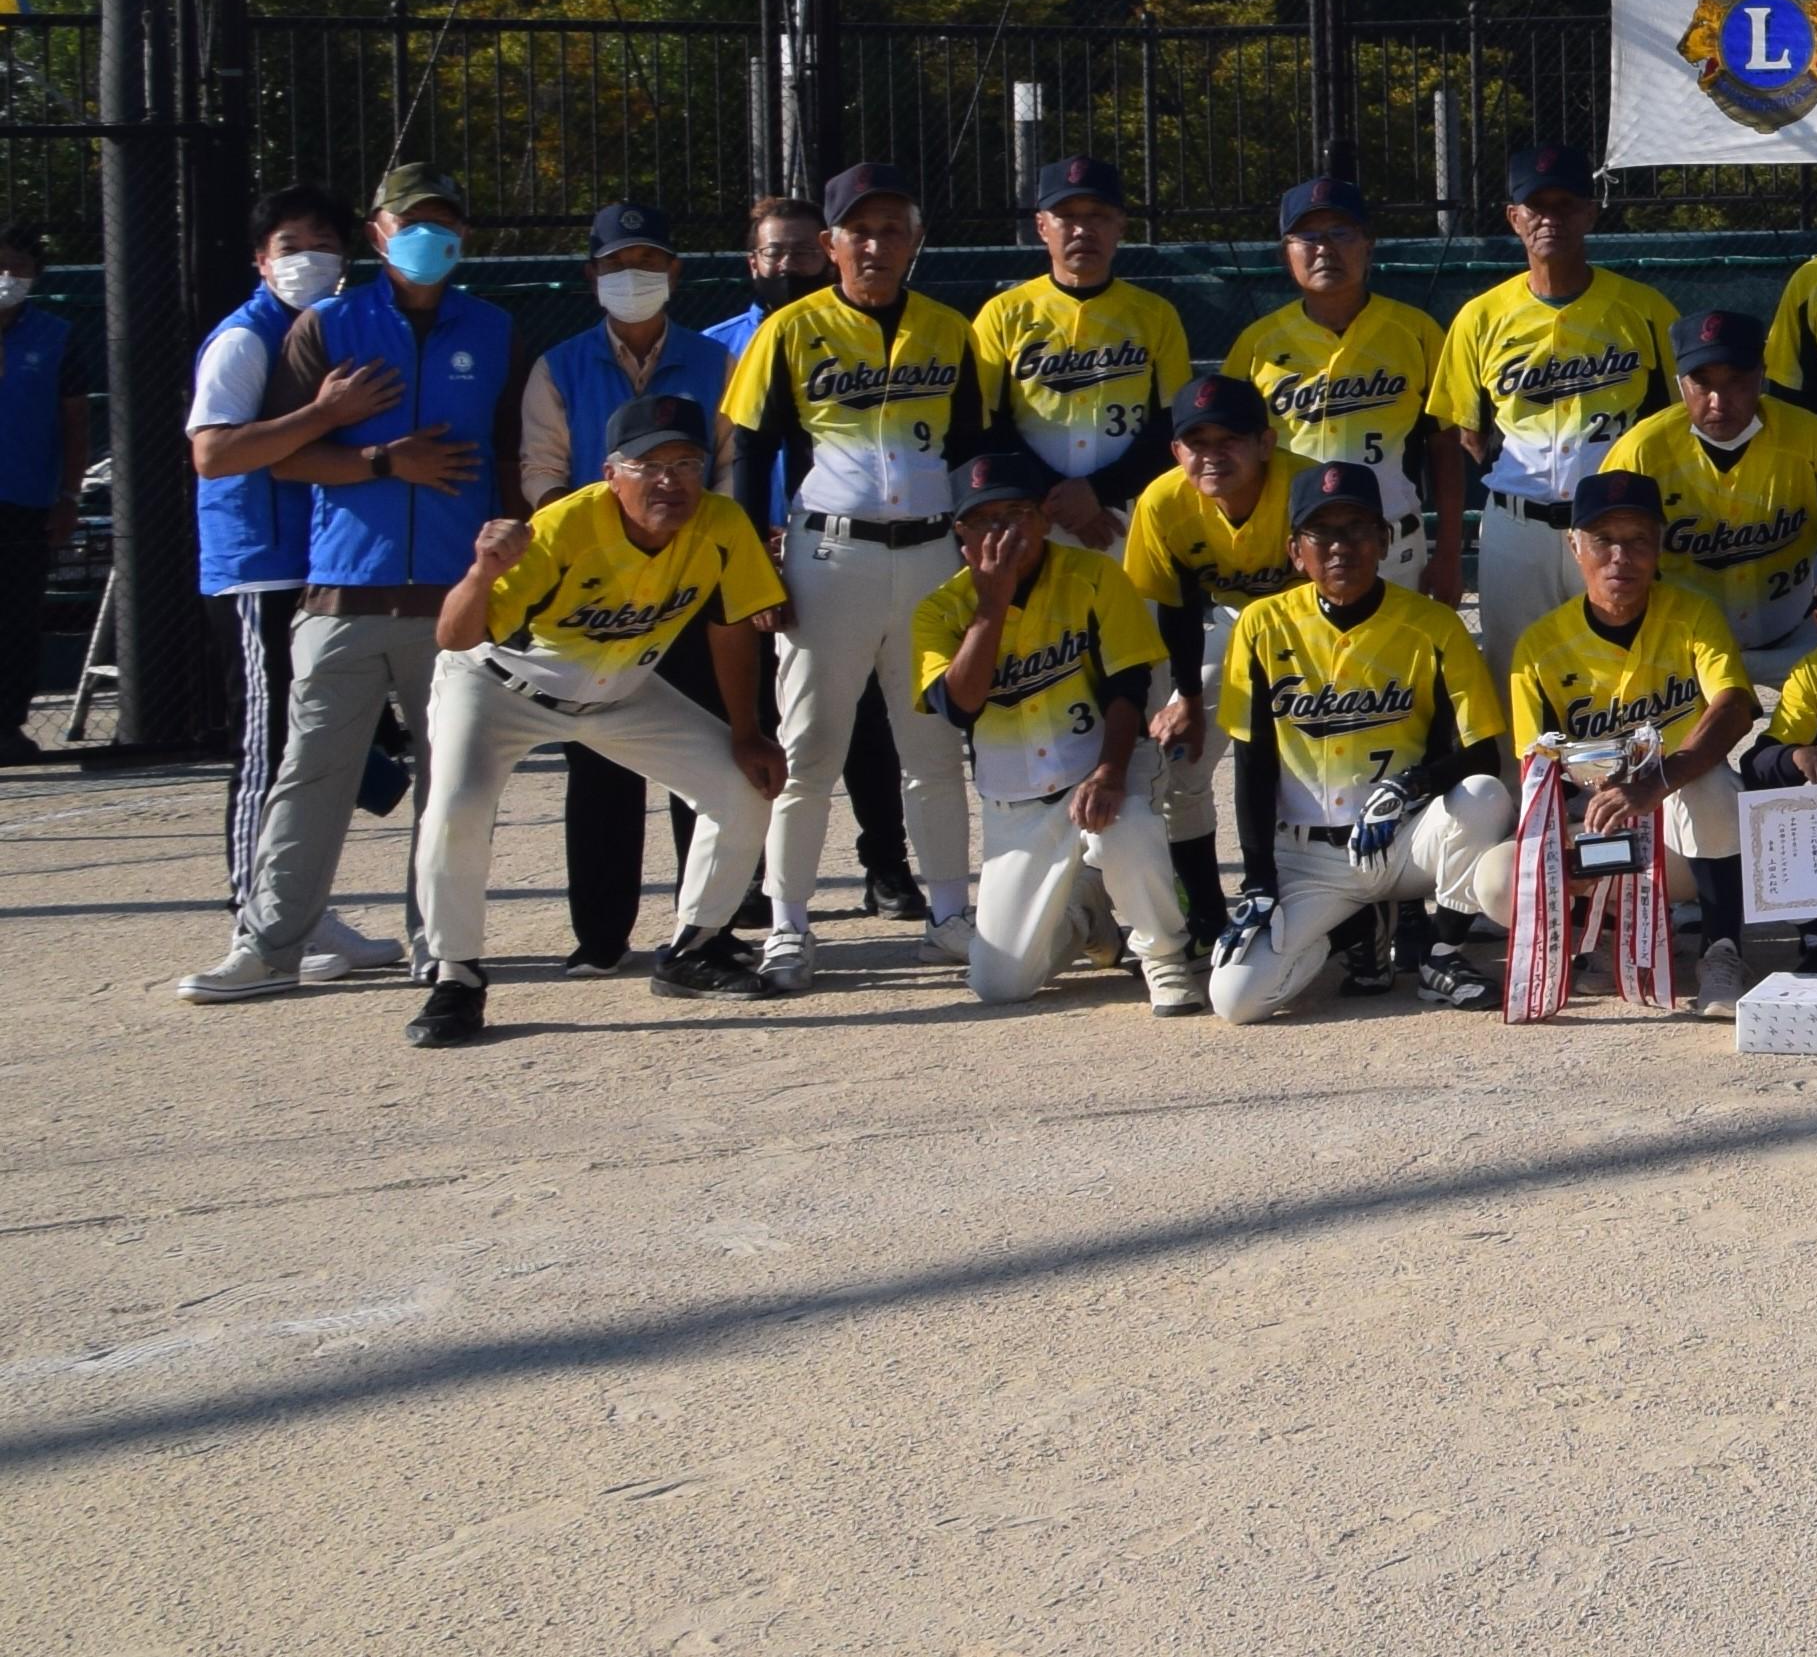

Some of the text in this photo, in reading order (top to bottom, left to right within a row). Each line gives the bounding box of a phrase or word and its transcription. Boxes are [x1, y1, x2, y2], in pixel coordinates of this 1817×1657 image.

[1743, 7, 1793, 70] L
[1014, 338, 1149, 382] Gokasho
[1498, 345, 1641, 394] Gokasho
[1271, 367, 1407, 417] Gokasho
[914, 421, 932, 452] 9
[1364, 432, 1384, 465] 5
[1663, 506, 1808, 557] Gokasho
[1067, 701, 1096, 736] 3
[1269, 674, 1414, 720] Gokasho
[1565, 673, 1702, 743] Gokasho
[1368, 749, 1395, 785] 7
